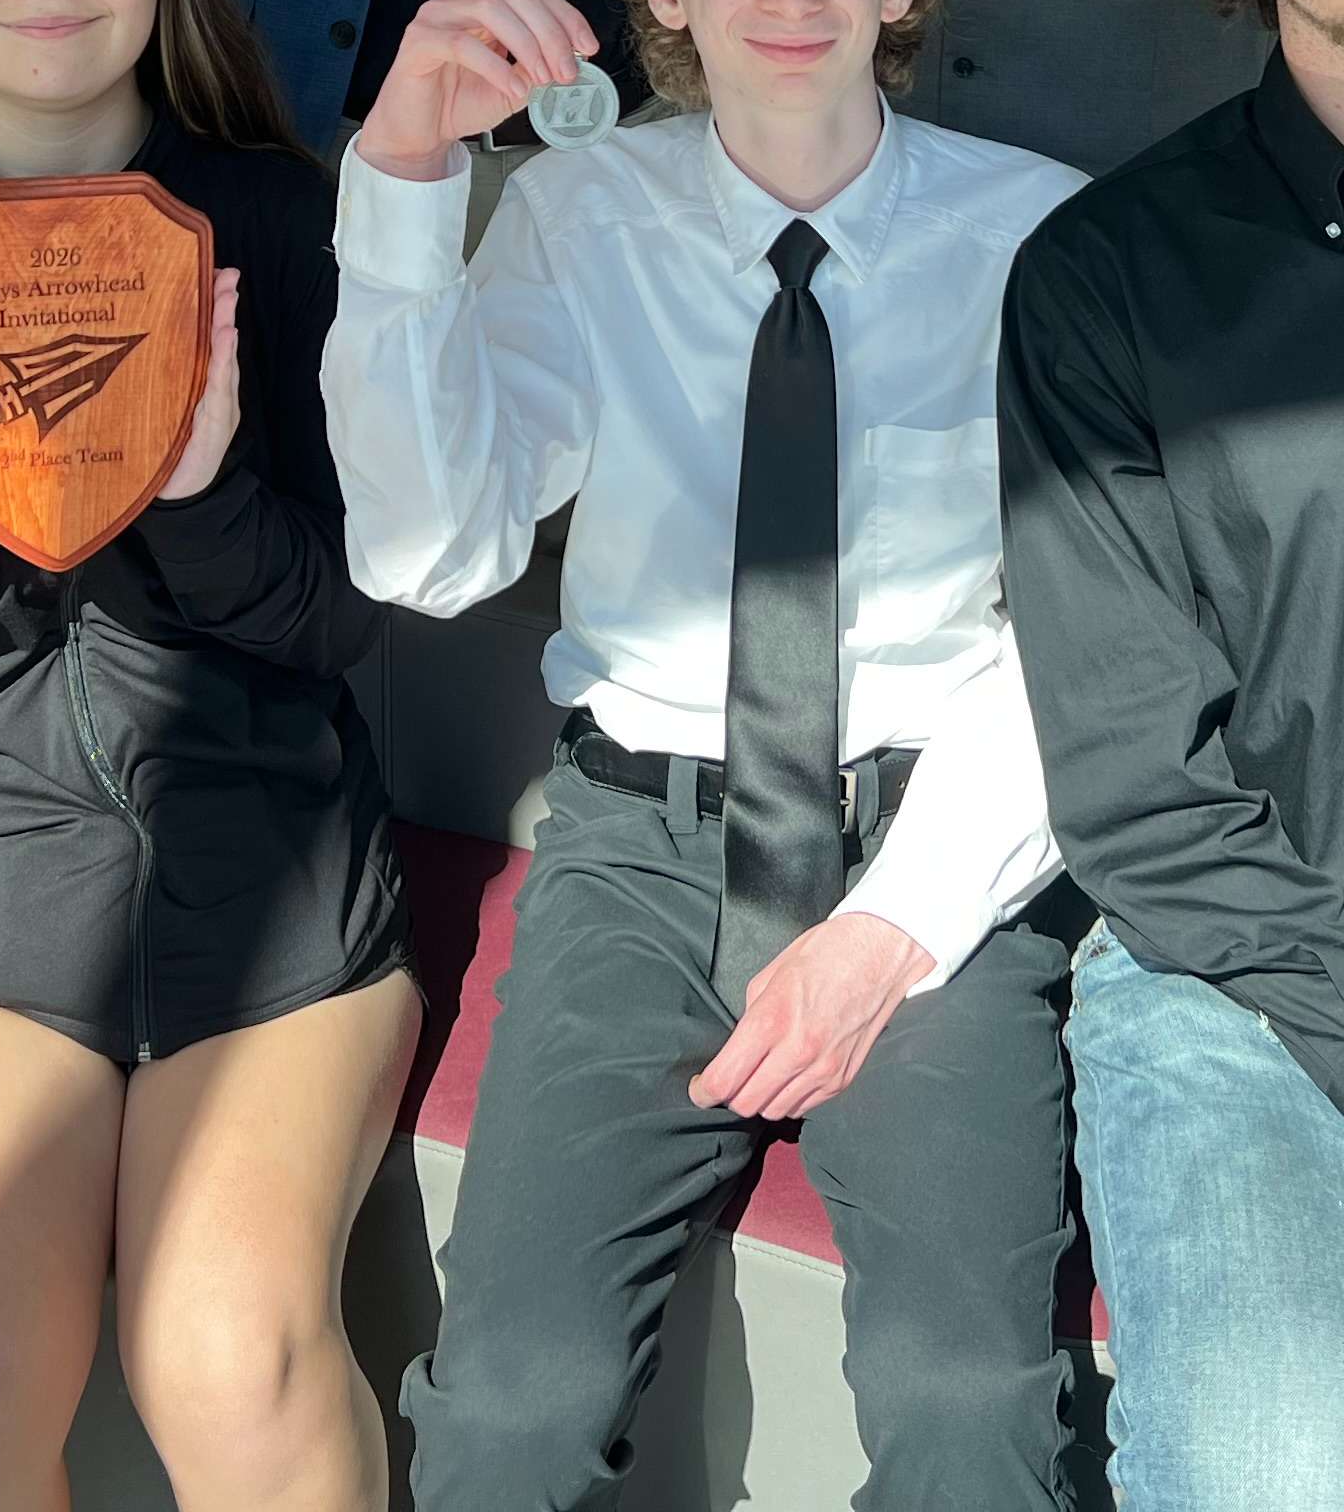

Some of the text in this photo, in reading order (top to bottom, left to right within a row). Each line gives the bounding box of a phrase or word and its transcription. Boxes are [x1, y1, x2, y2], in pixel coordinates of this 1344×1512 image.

[30, 247, 81, 268] 2026
[28, 272, 144, 297] Arrowhead
[0, 303, 115, 328] Invitational
[1, 448, 123, 469] 2nd Place Team
